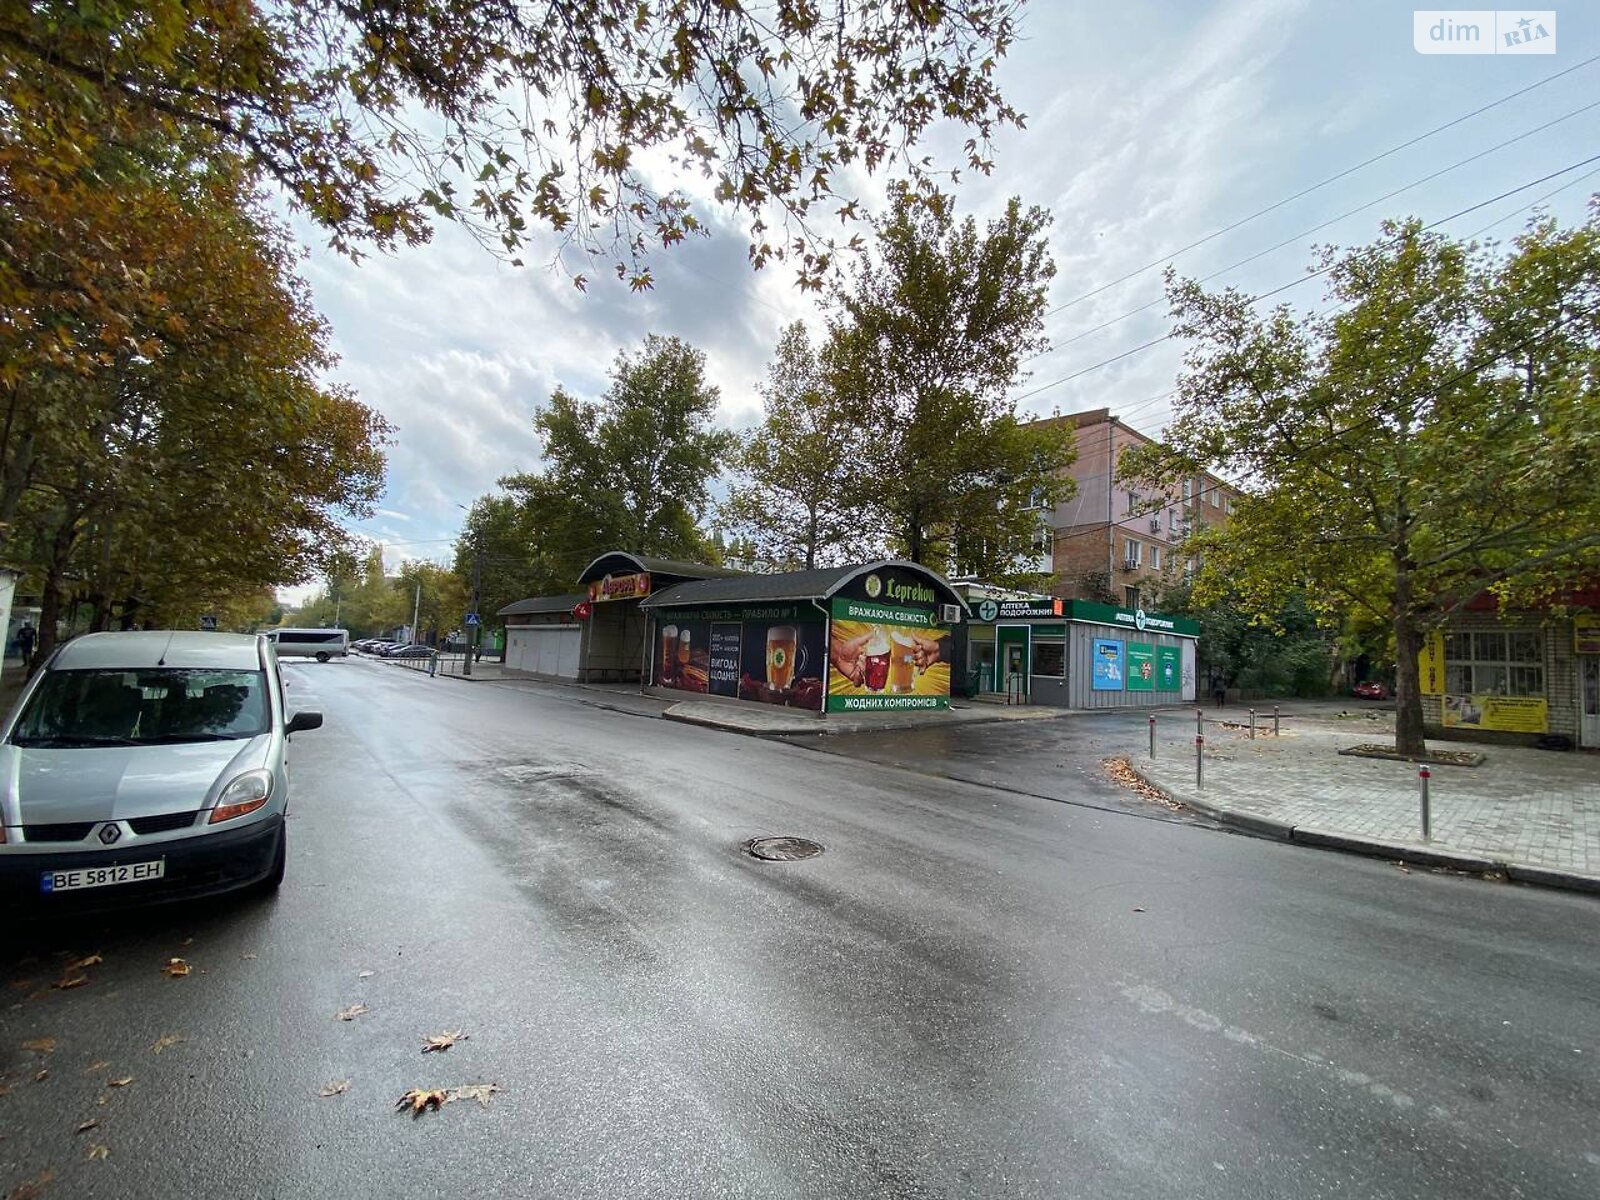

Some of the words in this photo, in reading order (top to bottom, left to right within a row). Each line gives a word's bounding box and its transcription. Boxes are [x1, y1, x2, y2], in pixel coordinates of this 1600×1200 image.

[886, 578, 934, 603] Leprekon
[848, 606, 895, 620] ВРАЖАЮЧА
[1000, 602, 1030, 610] АПТЕКА
[844, 698, 883, 709] ЖОДНИХ
[884, 698, 937, 708] КОМПРОМІСІВ
[54, 873, 81, 889] BE
[86, 867, 128, 885] 5812
[133, 863, 160, 879] EH
